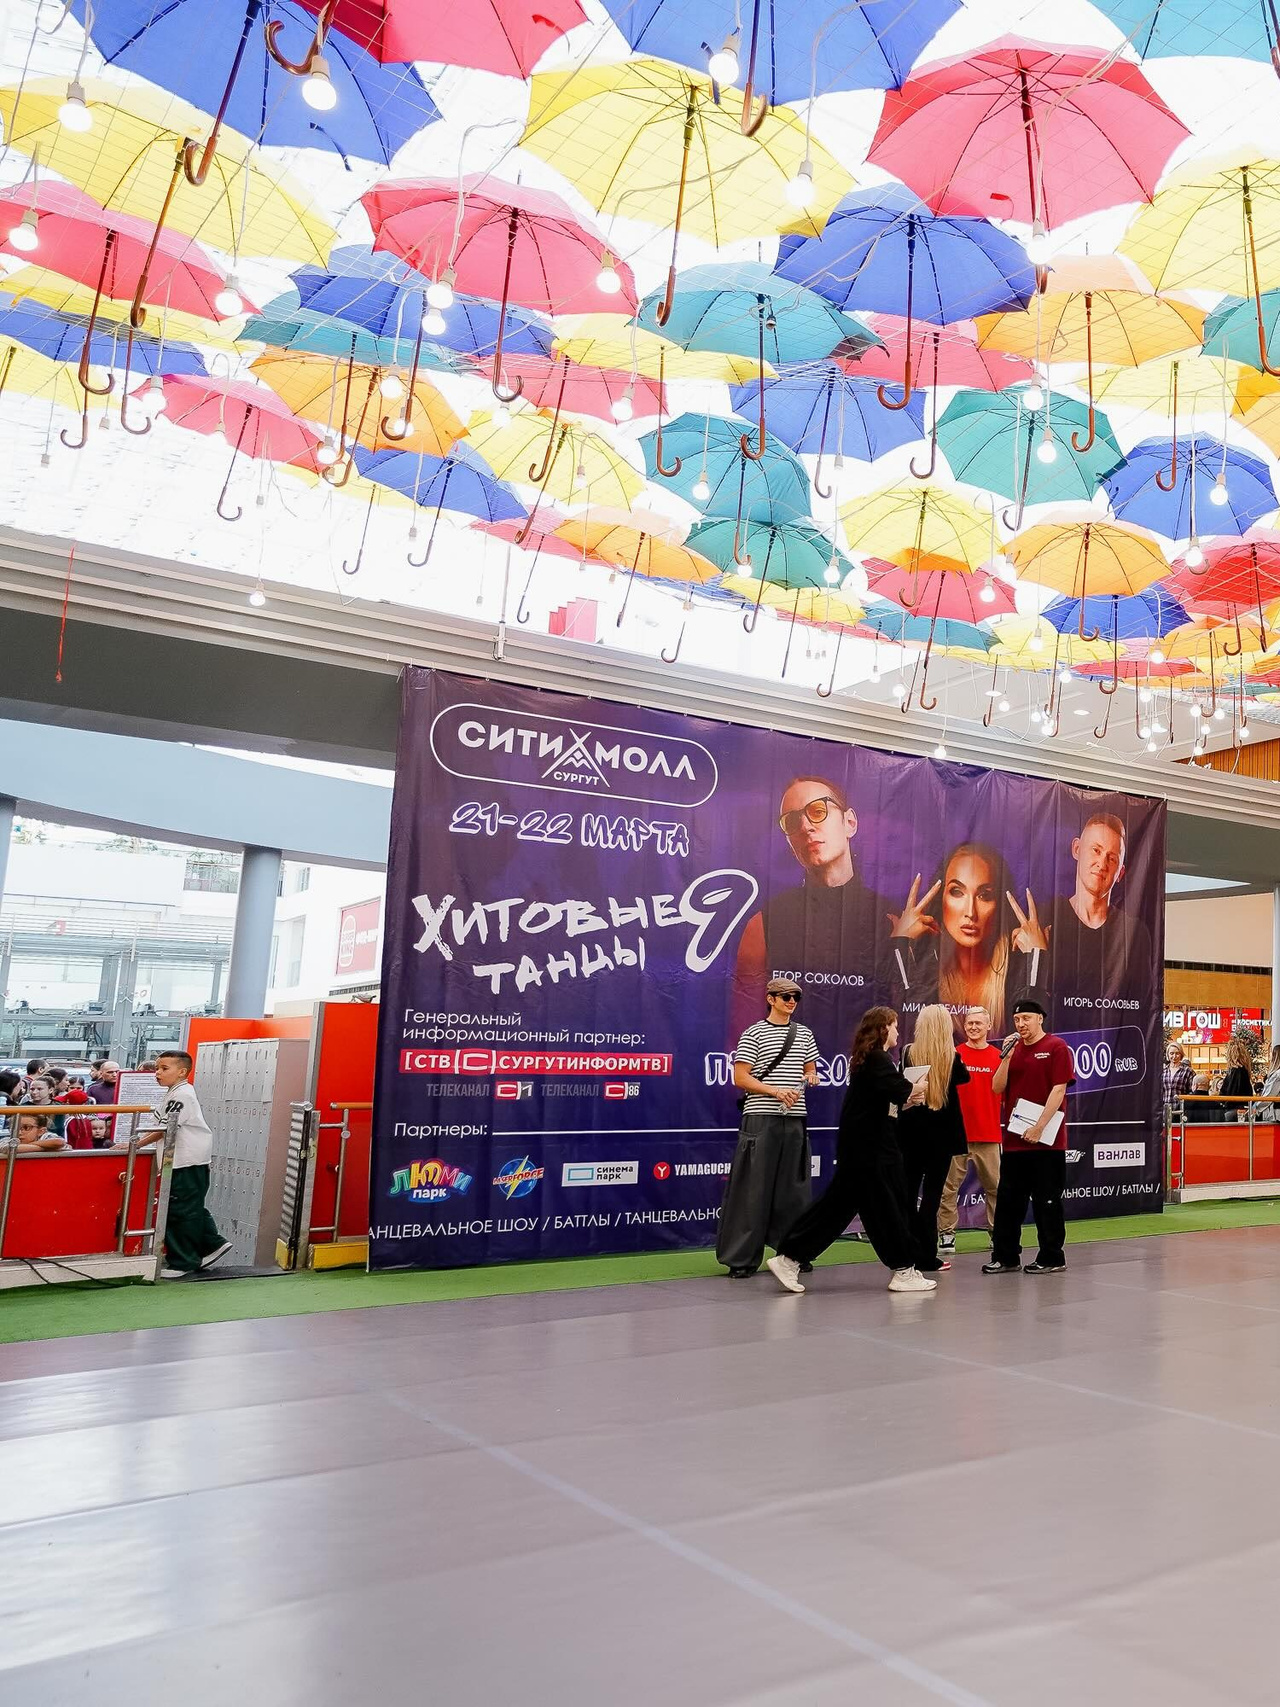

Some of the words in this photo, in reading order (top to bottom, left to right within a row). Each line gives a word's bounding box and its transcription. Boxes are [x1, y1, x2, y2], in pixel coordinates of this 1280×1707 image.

[457, 720, 565, 759] СИТИ
[594, 741, 697, 781] МОЛЛ
[553, 770, 600, 786] СУРГУТ
[449, 801, 574, 844] 21-22
[580, 812, 691, 857] МАРТА
[772, 970, 802, 983] ЕГОР
[805, 971, 865, 987] СОКОЛОВ
[1063, 996, 1093, 1008] ИГОРЬ
[1095, 998, 1140, 1010] СОЛОВЬЕВ
[404, 1008, 522, 1027] Генеральный
[1163, 1010, 1185, 1028] ИВ
[1187, 1010, 1221, 1029] ГОШ
[403, 1027, 569, 1044] информационный
[574, 1031, 646, 1048] партнер:
[1114, 1057, 1139, 1072] RUB
[426, 1083, 490, 1097] ТЕЛЕКАНАЛ
[541, 1083, 599, 1097] ТЕЛЕКАНАЛ
[394, 1122, 489, 1138] Партнеры:
[1097, 1149, 1141, 1161] ванлав
[596, 1165, 634, 1173] синема
[674, 1163, 732, 1176] YAMAGUCH
[390, 1162, 473, 1194] ЛЮМИ
[596, 1173, 622, 1182] парк
[412, 1188, 447, 1200] парк
[1092, 1185, 1115, 1198] ШОУ
[1121, 1183, 1154, 1195] БАТТЛЫ
[368, 1219, 493, 1240] АНЦЕВАЛЬНОЕ
[497, 1217, 539, 1233] ШОУ
[554, 1213, 611, 1229] БАТТЛЫ
[625, 1207, 722, 1225] ТАНЦЕВАЛЬН
